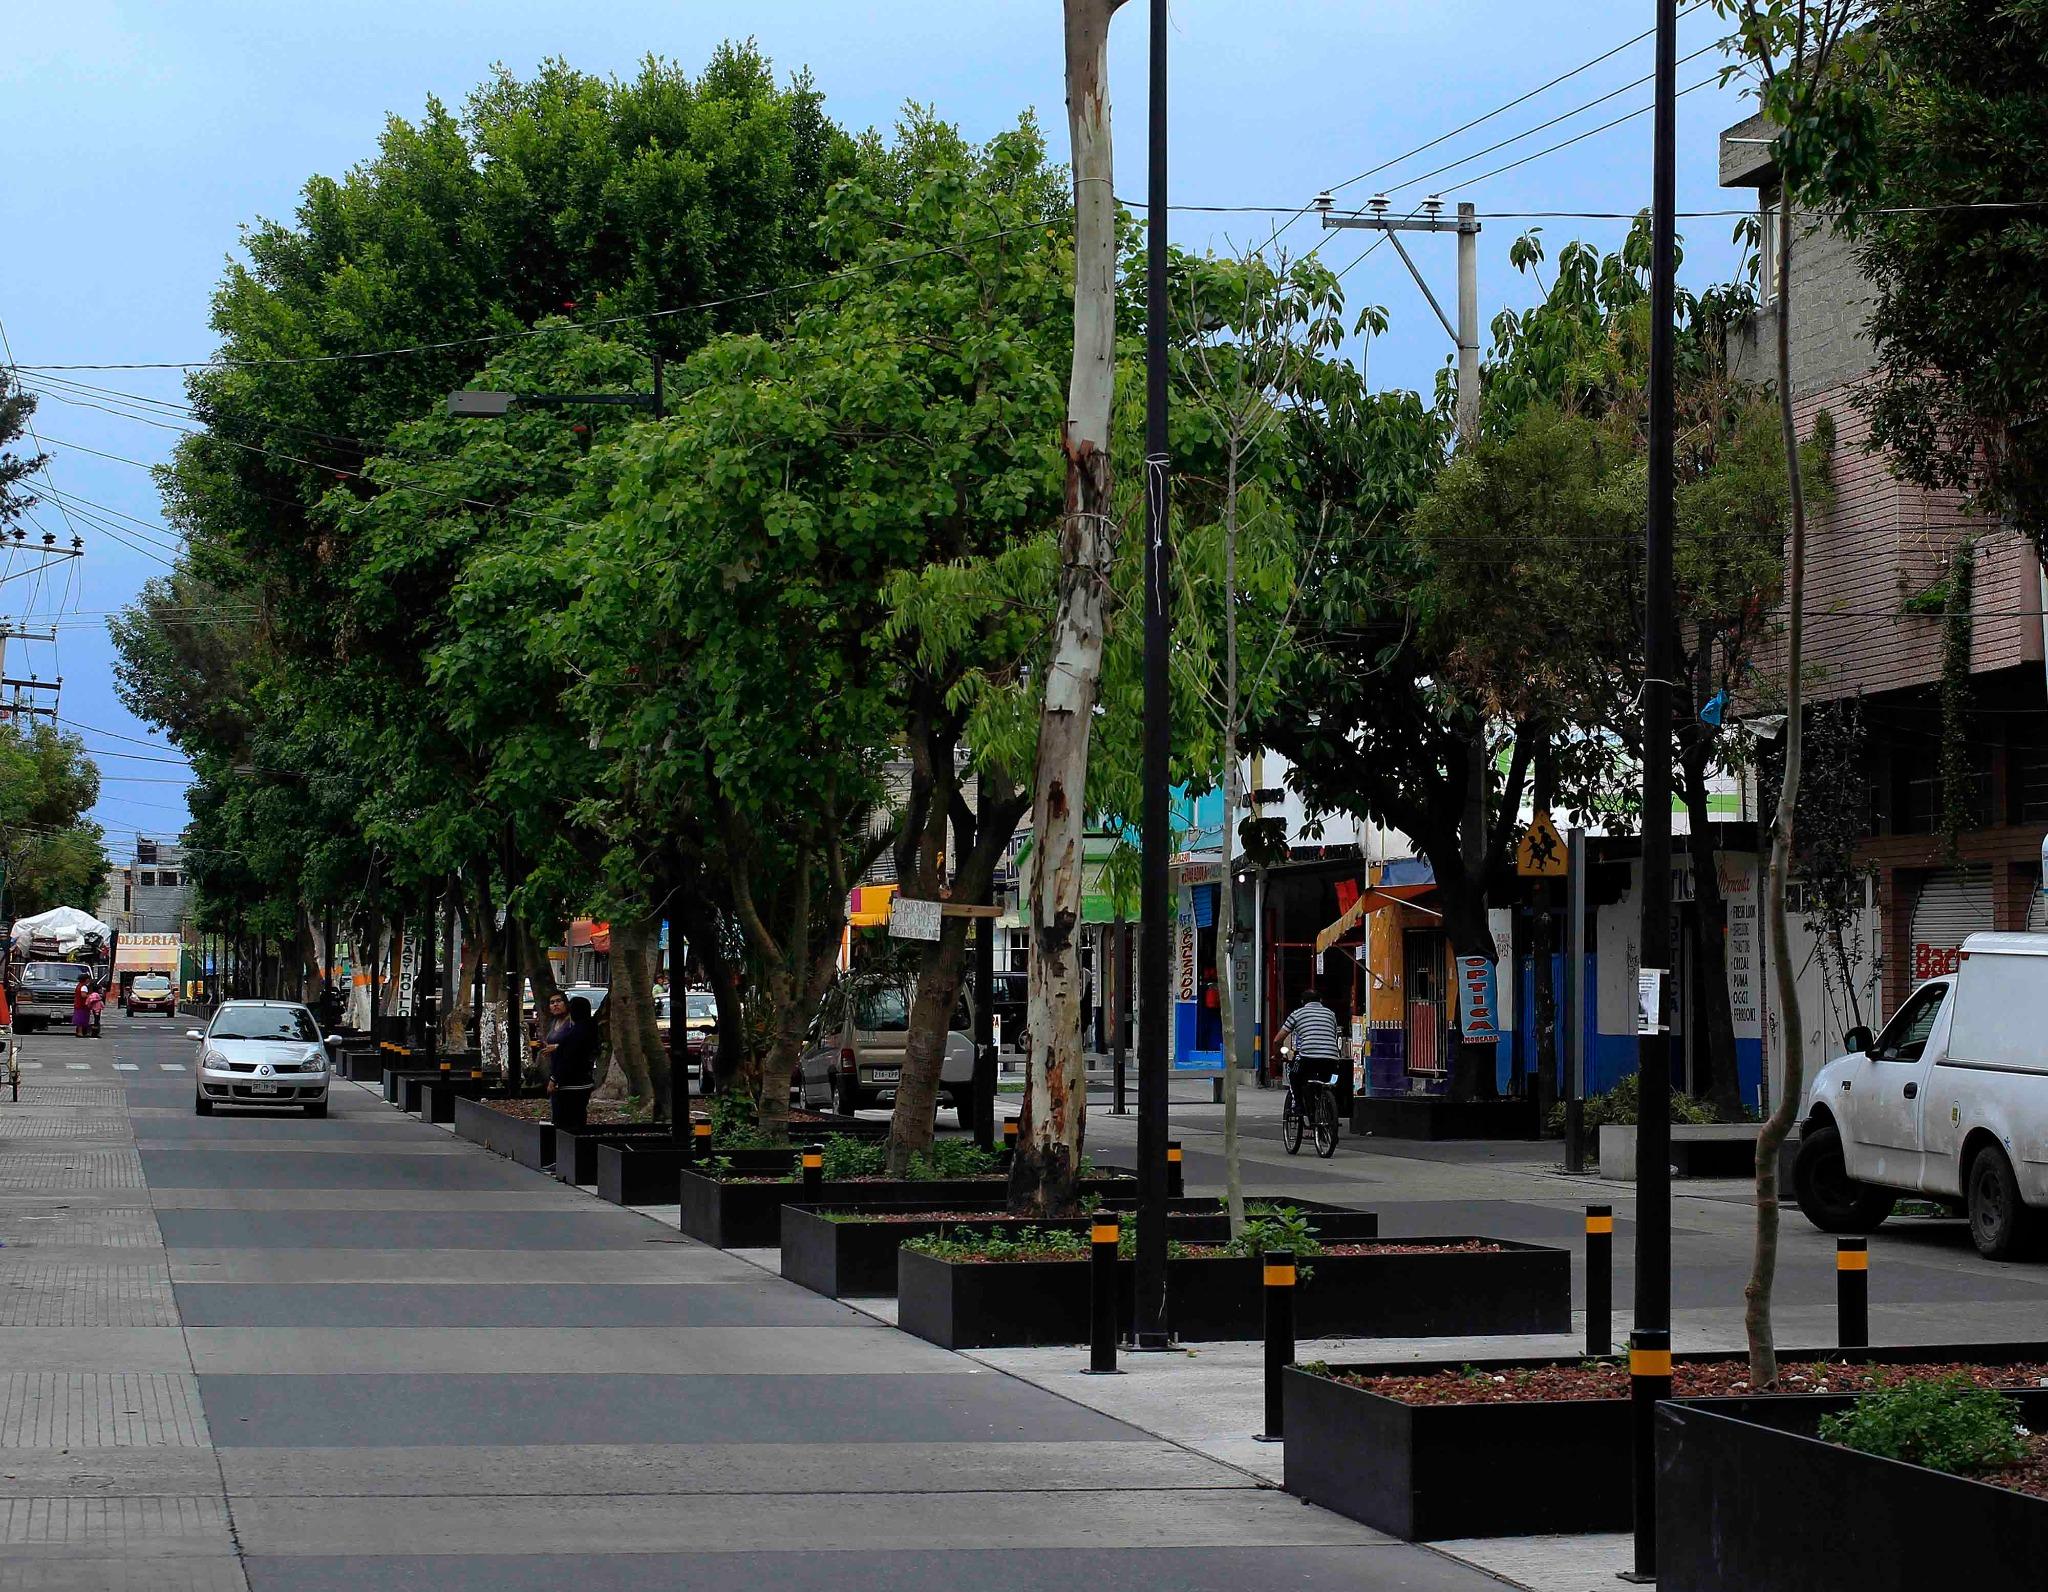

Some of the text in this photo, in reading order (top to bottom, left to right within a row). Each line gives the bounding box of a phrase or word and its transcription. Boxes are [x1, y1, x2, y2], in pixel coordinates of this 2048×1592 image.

[118, 934, 178, 946] OLLERIA
[1733, 974, 1748, 987] PUMA
[1465, 958, 1494, 1031] OPTICA
[1733, 991, 1749, 1004] OGGI
